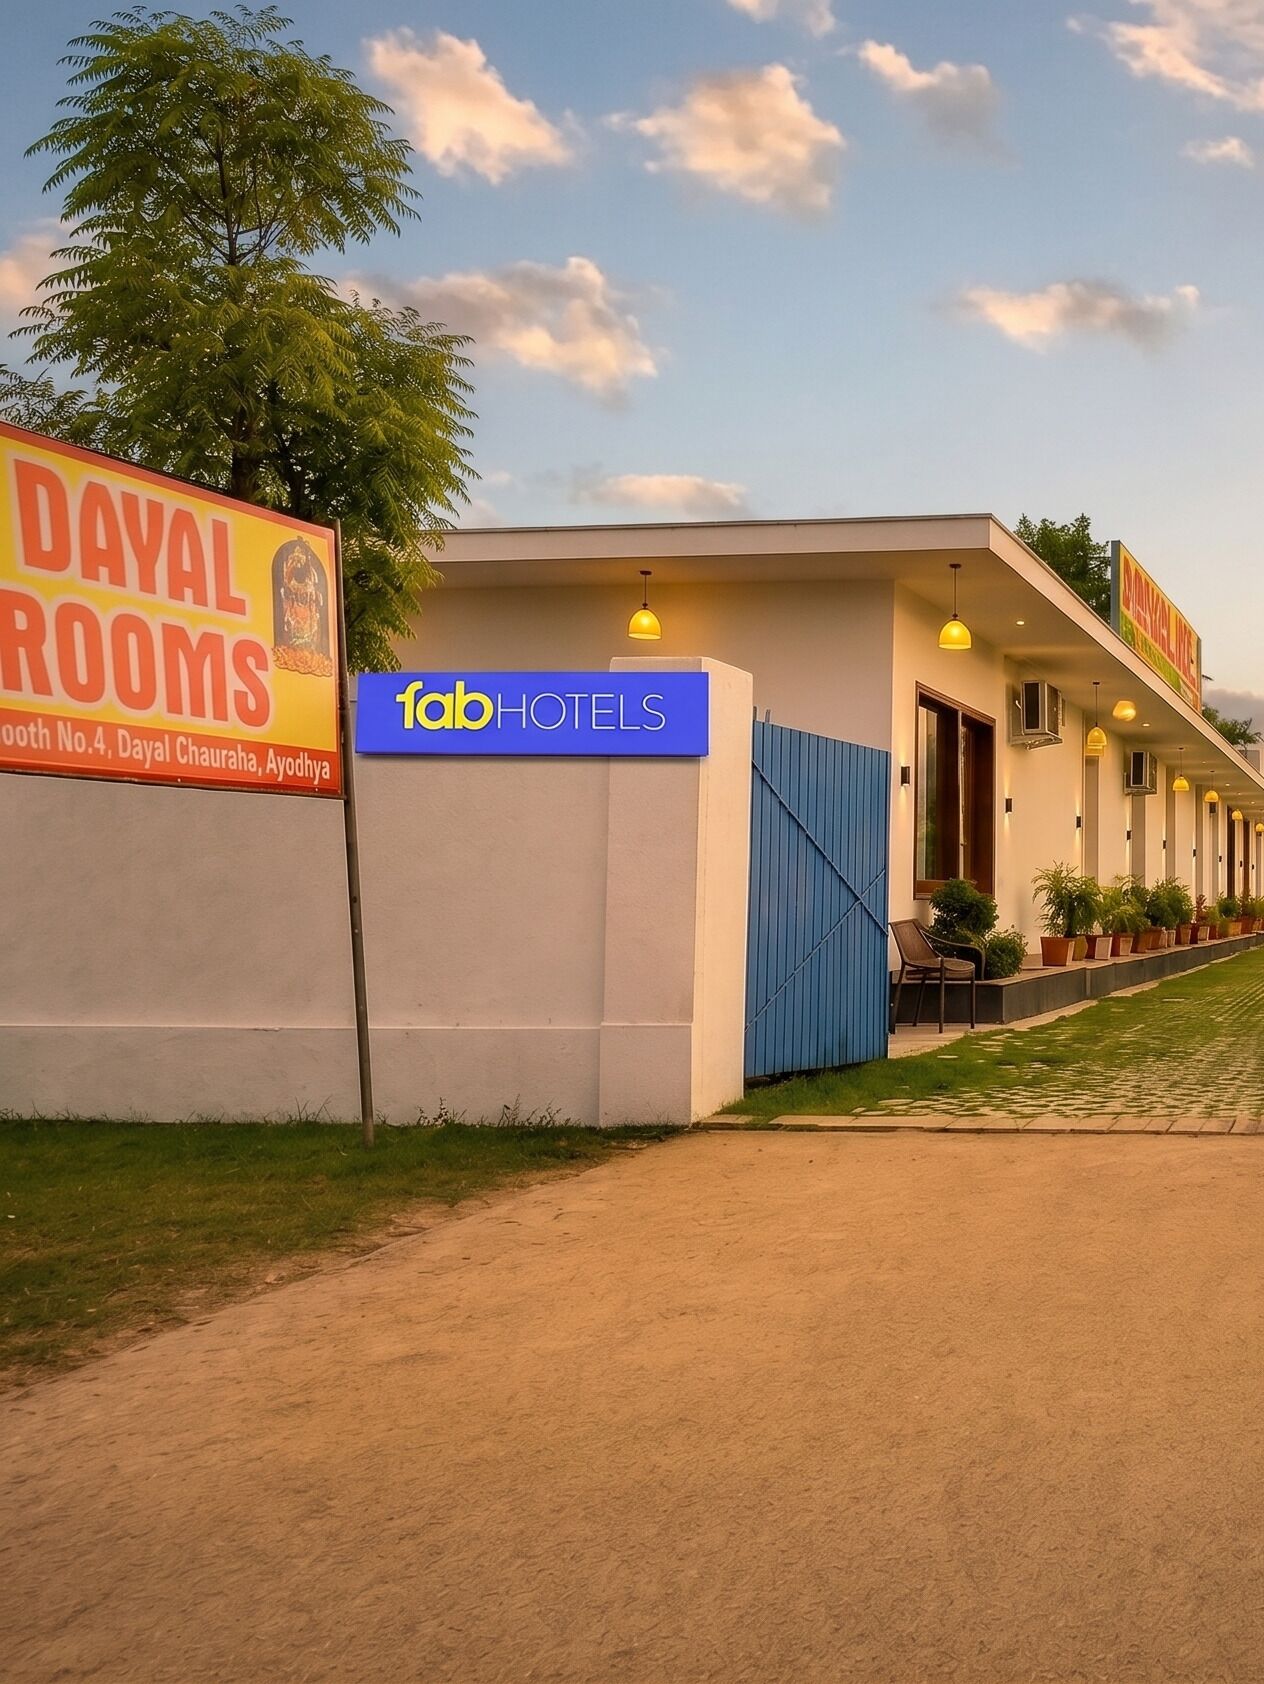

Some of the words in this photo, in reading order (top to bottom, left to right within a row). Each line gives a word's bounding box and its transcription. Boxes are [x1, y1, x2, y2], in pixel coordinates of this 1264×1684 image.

[12, 457, 248, 618] DAYAL
[0, 587, 272, 729] ROOMS
[57, 720, 112, 759] No.4,
[117, 728, 170, 769] Dayal
[176, 735, 262, 777] Chauraha,
[266, 748, 330, 785] Ayodhya
